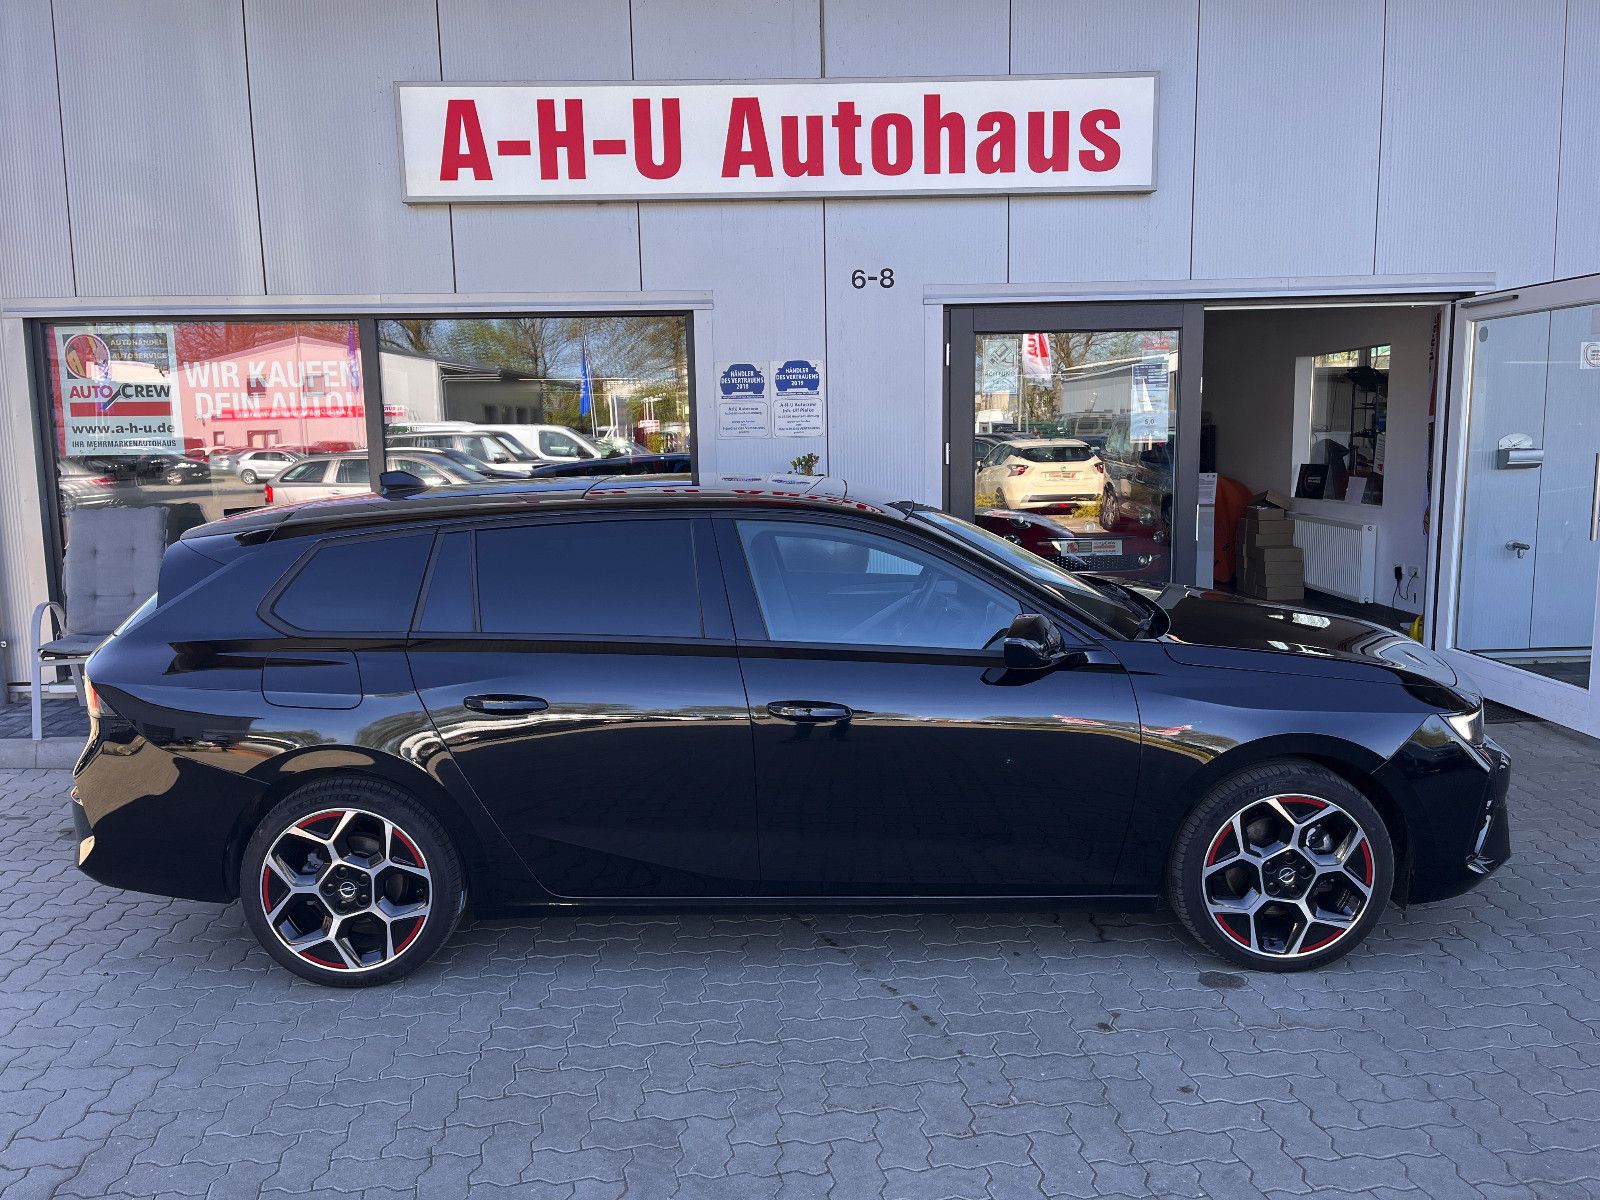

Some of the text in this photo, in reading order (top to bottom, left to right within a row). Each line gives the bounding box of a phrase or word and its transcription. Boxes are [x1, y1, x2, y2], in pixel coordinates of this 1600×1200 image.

[440, 94, 1120, 181] A-H-U Autohaus
[852, 268, 894, 289] 6-8
[184, 361, 240, 388] WIR
[70, 383, 171, 399] AUTO CREW
[195, 392, 261, 419] DEIN
[72, 423, 175, 434] www.a-h-u.de
[86, 440, 177, 448] MEHRMARKENAUTOHAUS
